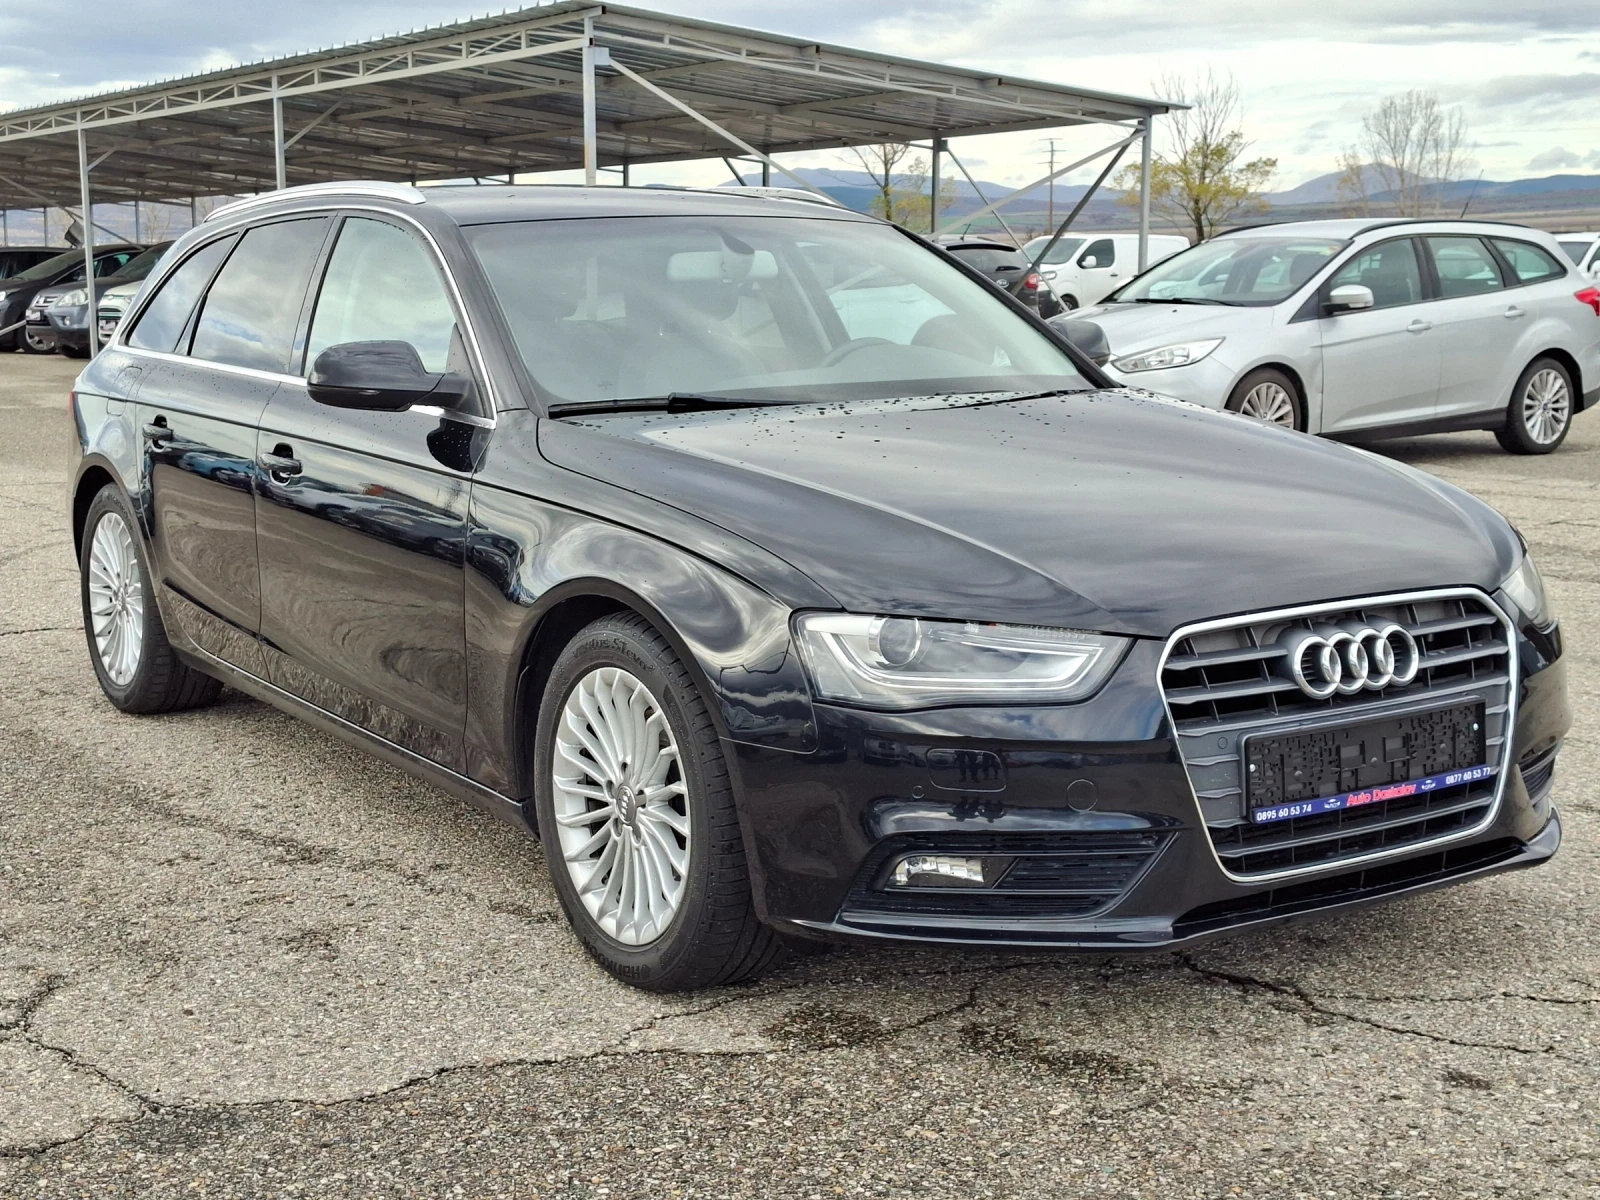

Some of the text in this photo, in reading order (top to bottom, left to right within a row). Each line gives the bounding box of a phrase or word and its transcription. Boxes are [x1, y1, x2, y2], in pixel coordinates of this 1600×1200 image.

[1256, 812, 1277, 821] 0895
[1278, 809, 1289, 818] 60
[1290, 807, 1300, 816] 53
[1302, 804, 1312, 813] 74
[1346, 793, 1372, 807] Auto
[1445, 773, 1462, 785] 0877
[1463, 771, 1472, 780] 60
[1472, 769, 1482, 778] 53
[1483, 767, 1491, 776] 77
[582, 936, 641, 979] Hankook
